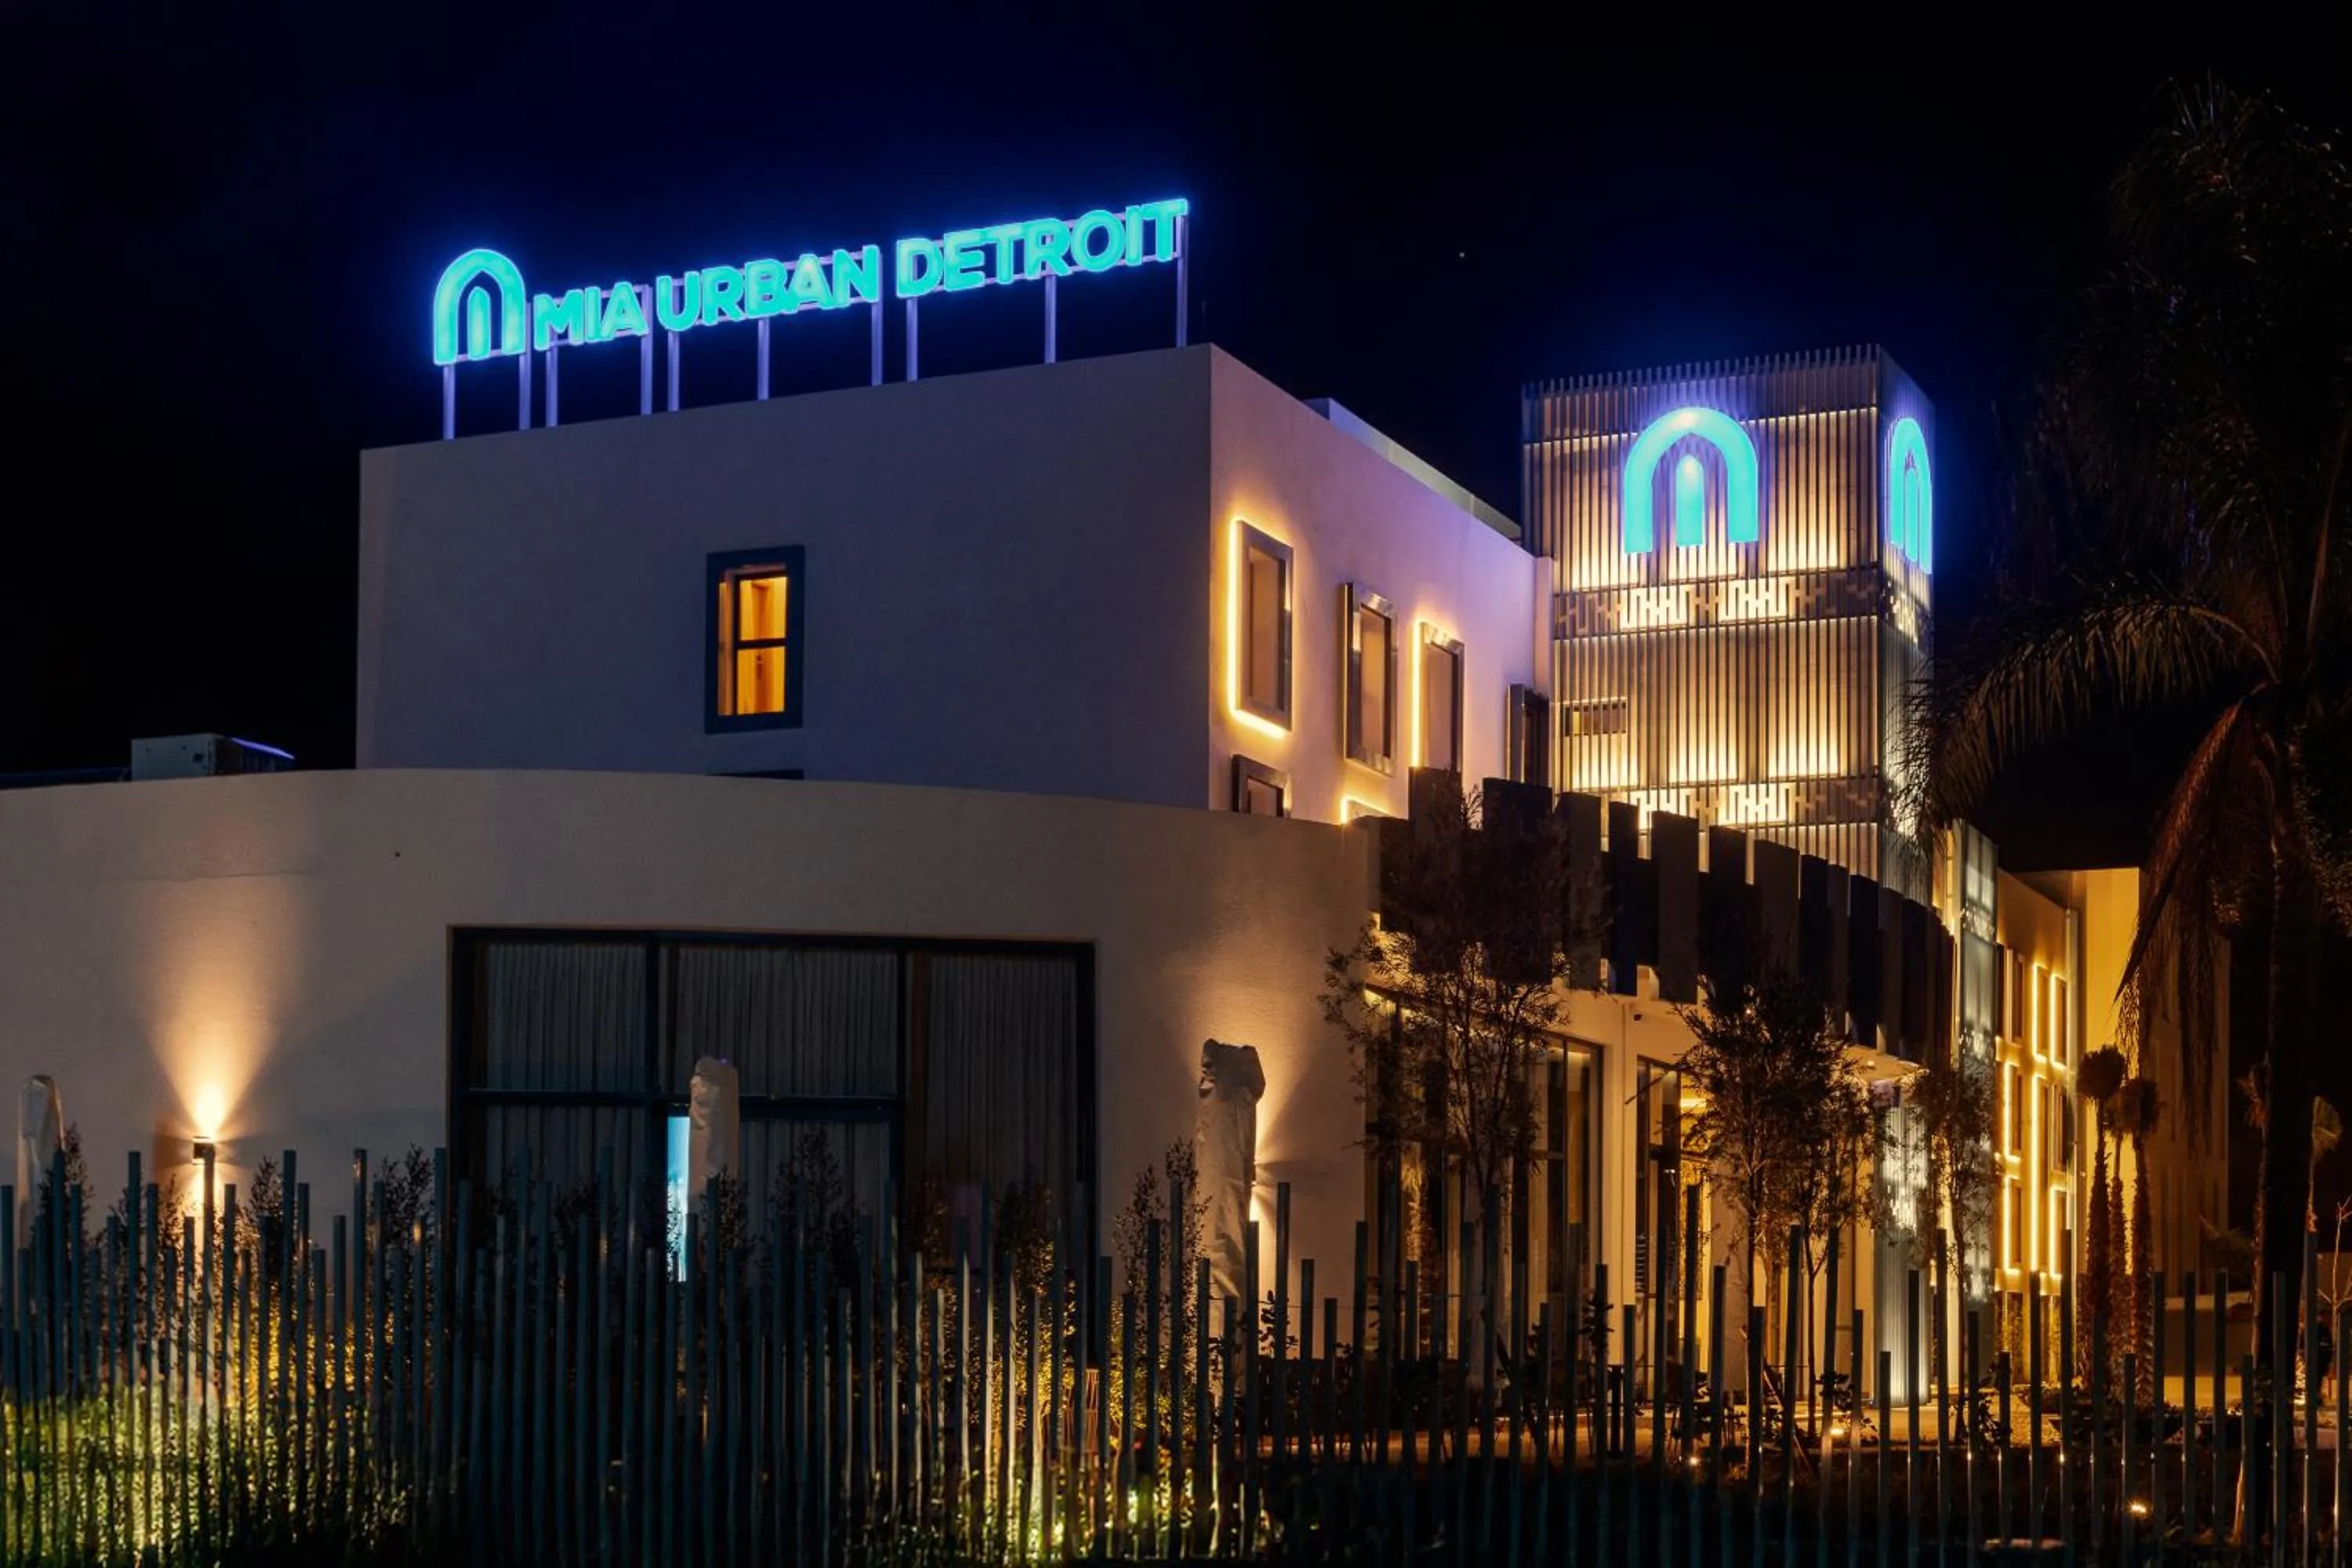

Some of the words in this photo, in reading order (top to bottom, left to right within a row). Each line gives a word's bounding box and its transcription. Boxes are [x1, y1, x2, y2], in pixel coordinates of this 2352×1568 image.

[534, 282, 650, 350] MIA
[656, 245, 880, 332] URBAN
[896, 198, 1188, 298] DETROIT
